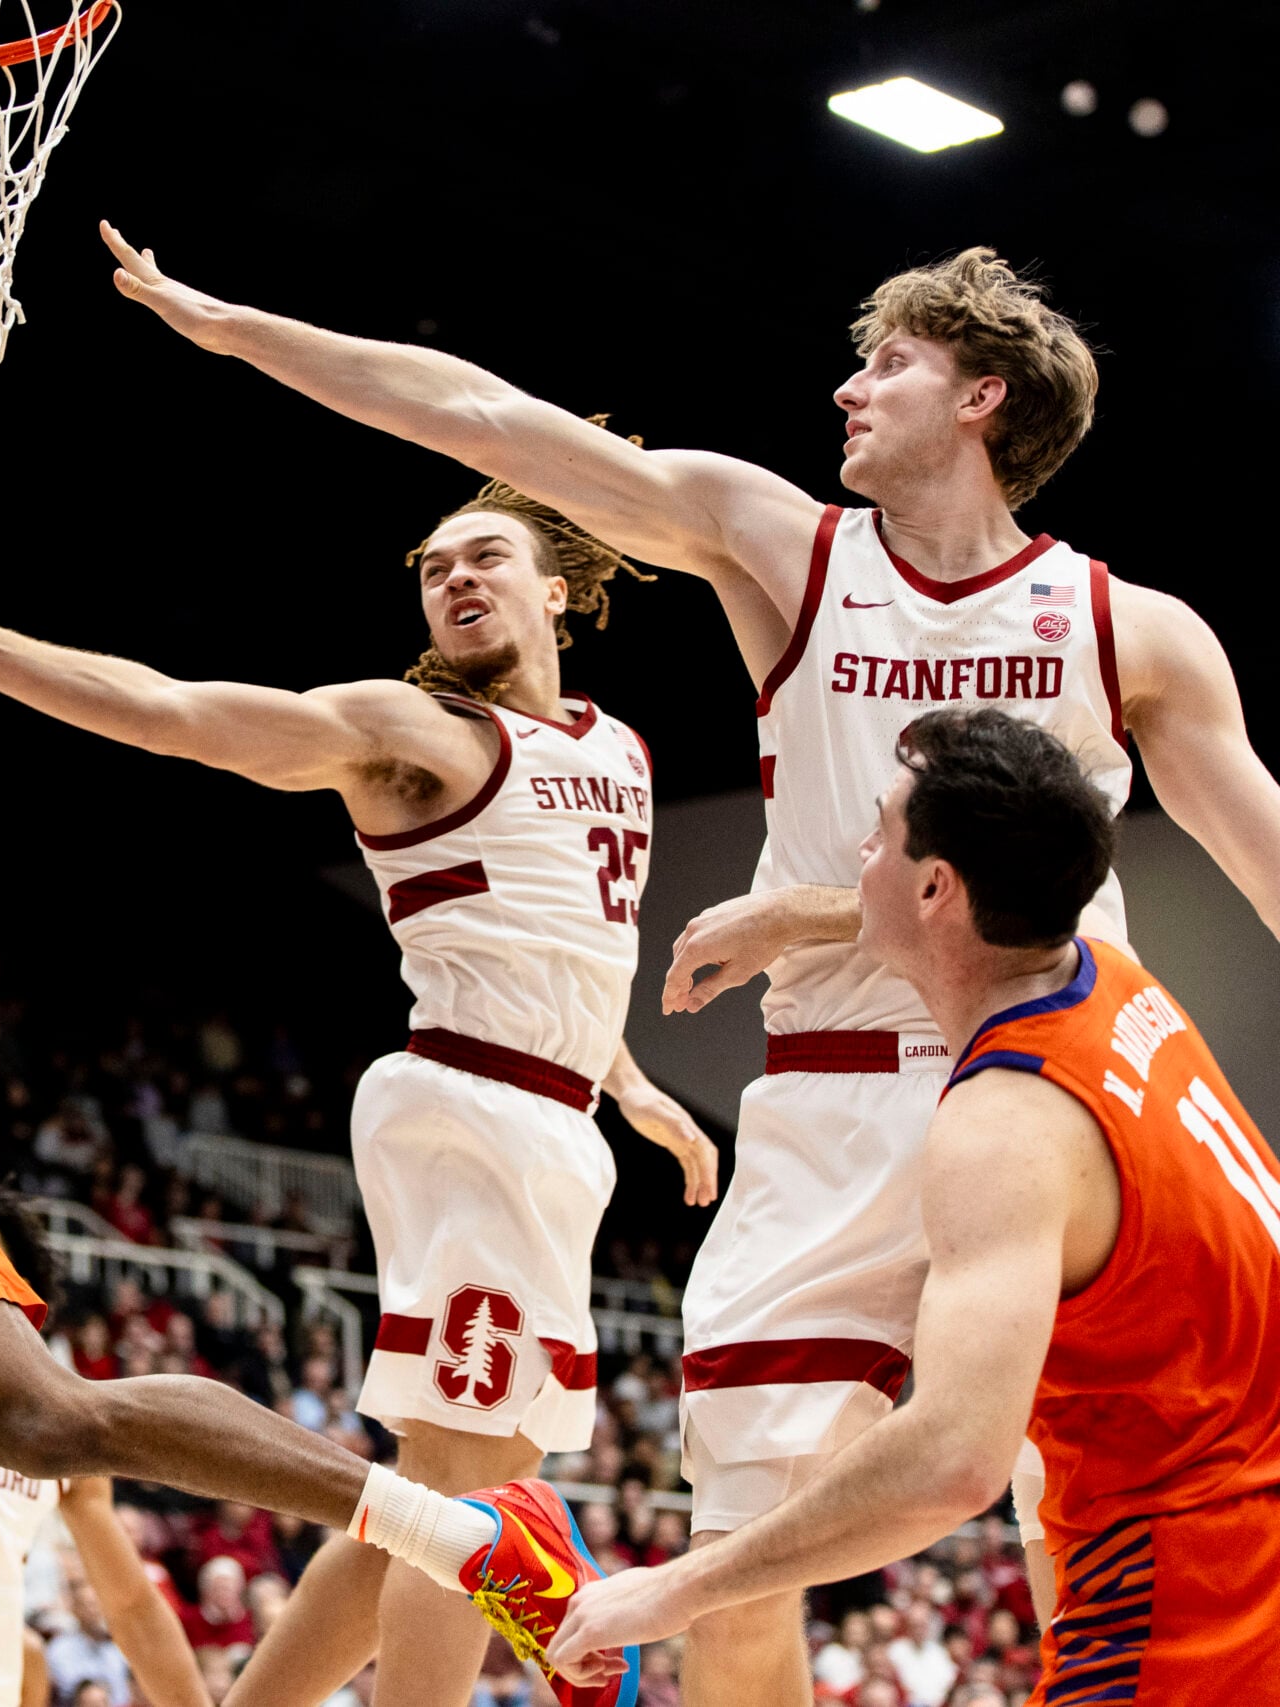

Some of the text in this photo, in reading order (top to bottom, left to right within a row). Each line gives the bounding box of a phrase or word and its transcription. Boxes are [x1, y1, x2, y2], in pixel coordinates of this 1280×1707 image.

[831, 652, 1064, 701] STANFORD
[587, 827, 649, 926] 25
[905, 1045, 952, 1057] CARDIN
